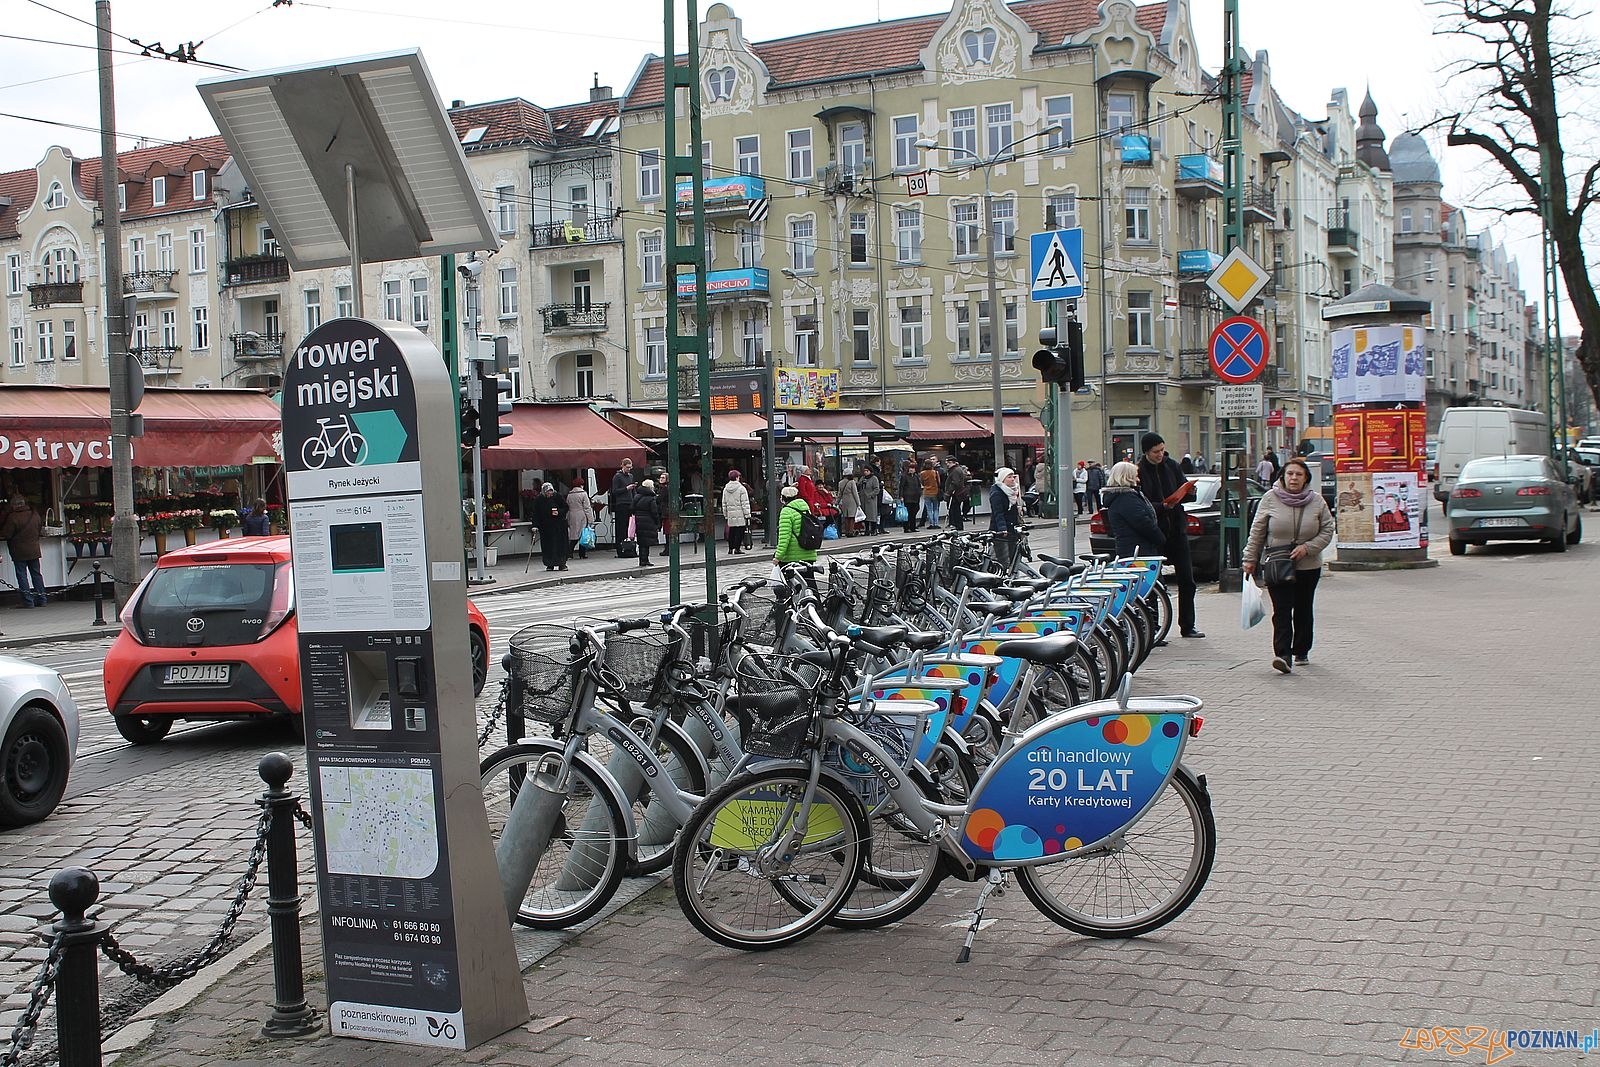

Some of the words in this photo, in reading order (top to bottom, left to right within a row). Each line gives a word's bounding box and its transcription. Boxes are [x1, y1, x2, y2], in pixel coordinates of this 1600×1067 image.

[910, 178, 924, 190] 30
[297, 337, 379, 370] rower
[297, 366, 399, 408] miejski
[329, 479, 351, 489] Rynek
[353, 476, 380, 488] Jeżycki
[354, 506, 371, 515] 6164
[171, 667, 188, 679] PO
[191, 666, 227, 679] 7J115
[695, 705, 716, 731] 68513
[622, 740, 648, 766] 68261
[1027, 748, 1052, 763] citi
[1056, 748, 1131, 766] handlowy
[862, 751, 890, 778] 68710
[1028, 768, 1067, 791] 20
[1077, 769, 1134, 791] LAT
[1028, 795, 1061, 808] Karty
[1064, 796, 1132, 809] Kredytowej
[743, 819, 758, 829] NIE
[331, 916, 378, 929] INFOLINIA
[393, 920, 402, 929] 61
[419, 922, 429, 931] 80
[430, 923, 440, 932] 80
[394, 932, 403, 941] 61
[405, 933, 419, 943] 674
[420, 935, 430, 944] 03
[431, 935, 442, 945] 90
[341, 1009, 417, 1027] poznanskirower.pl
